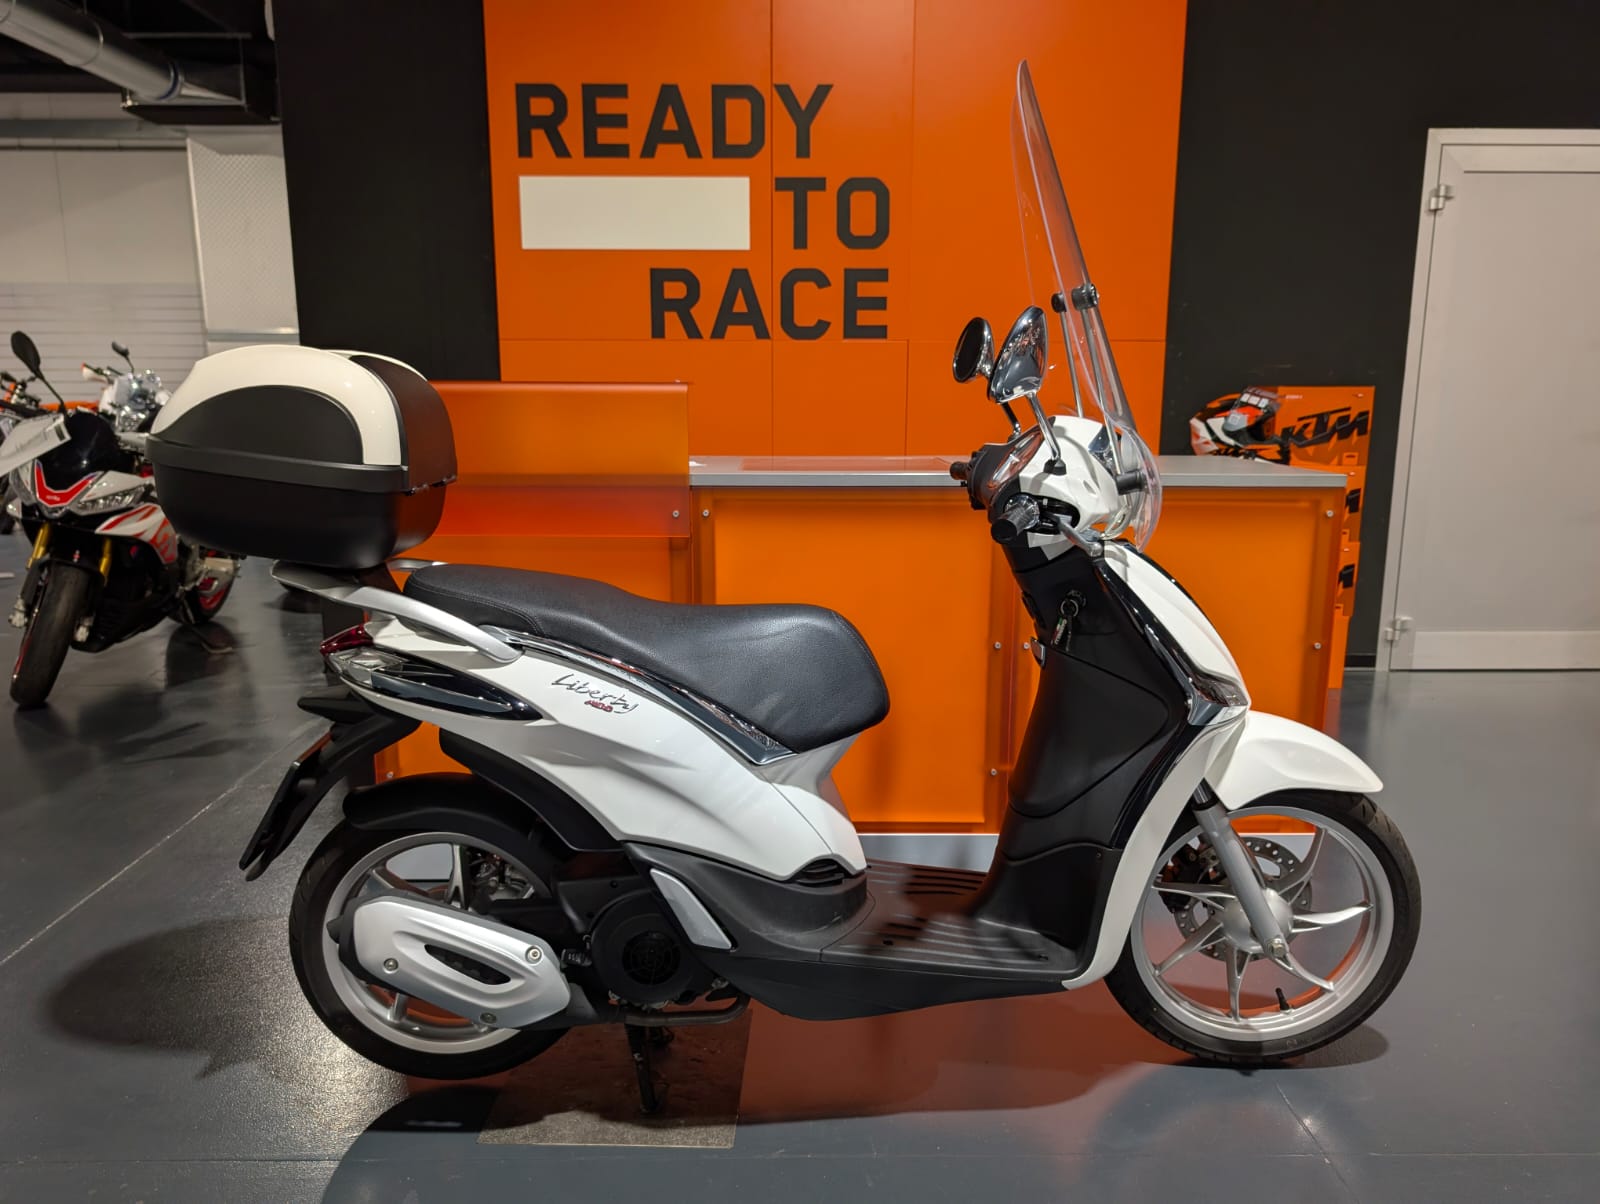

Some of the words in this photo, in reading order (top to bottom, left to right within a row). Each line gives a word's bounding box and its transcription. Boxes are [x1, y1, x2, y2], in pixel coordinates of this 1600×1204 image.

[515, 83, 834, 158] READY
[774, 176, 890, 250] TO
[649, 267, 889, 340] RACE
[1280, 407, 1370, 448] KTM
[551, 673, 639, 714] Liberty
